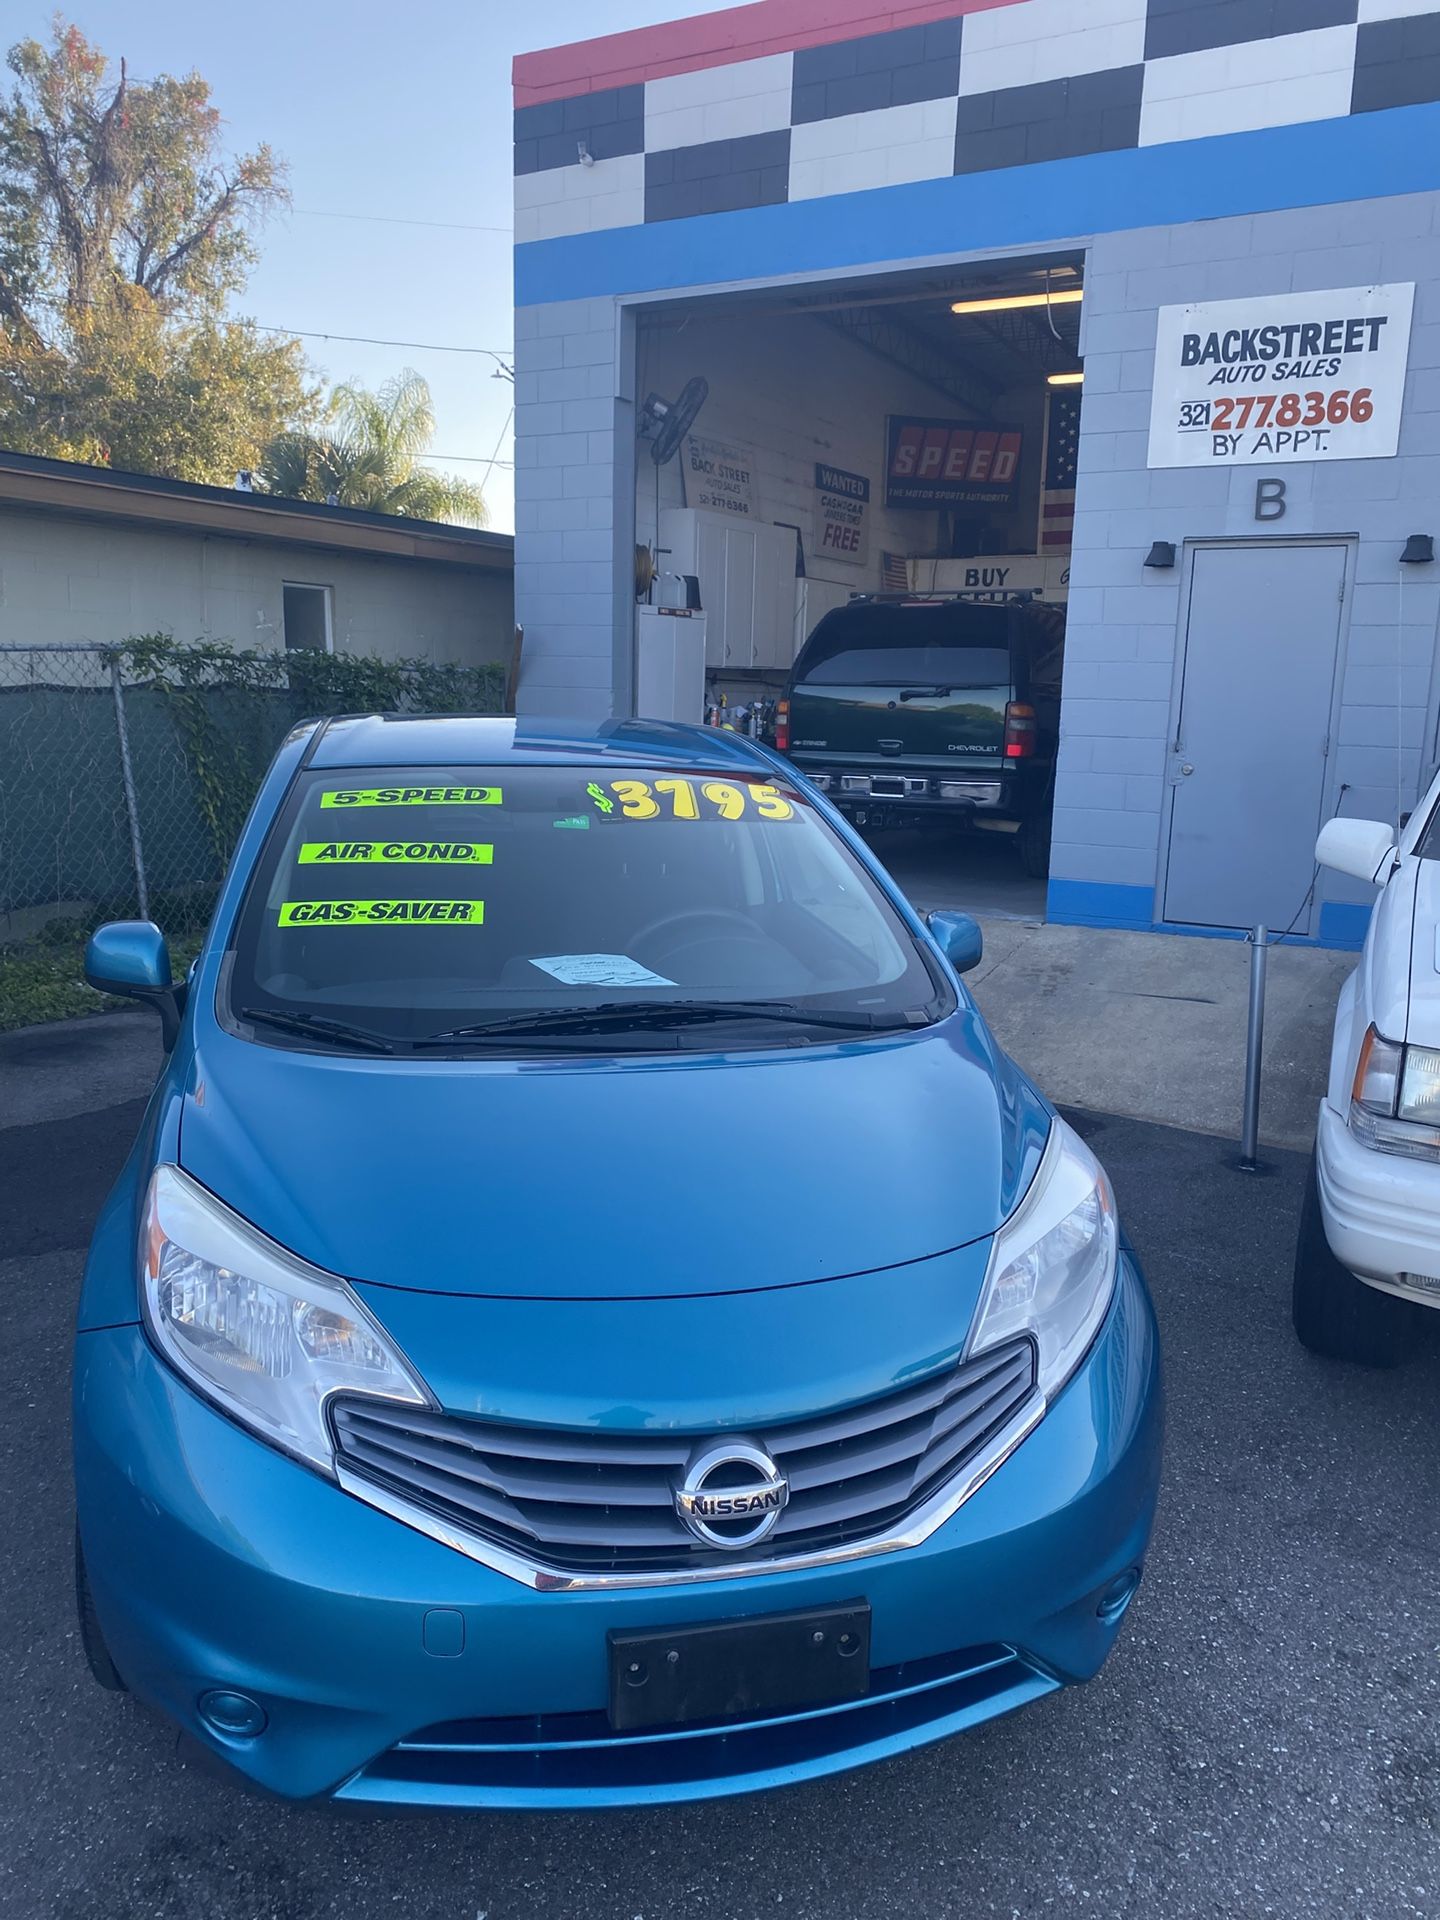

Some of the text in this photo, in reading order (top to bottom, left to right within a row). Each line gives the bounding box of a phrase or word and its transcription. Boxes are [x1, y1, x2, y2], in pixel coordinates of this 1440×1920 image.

[1181, 316, 1388, 367] BACKSTREET
[1207, 357, 1342, 386] AUTO SALES
[1178, 387, 1374, 431] 321 277.8366
[1212, 429, 1331, 456] BY APPT.
[691, 457, 751, 484] BACK STREET
[895, 445, 1016, 480] SPEED
[705, 478, 742, 494] AUTO SALES
[821, 469, 865, 496] WANTED
[888, 487, 1011, 503] THE MOTOR SPORTS AUTHORITY
[821, 495, 842, 510] CASH
[847, 503, 864, 517] CAR
[1254, 478, 1287, 521] B
[822, 523, 861, 552] FREE
[965, 568, 1010, 587] BUY
[947, 744, 998, 752] CHEVROLET
[332, 787, 490, 806] 5-SPEED
[314, 843, 481, 861] AIR COND.
[288, 901, 476, 923] GAS-SAVER
[691, 1491, 779, 1515] NISSAN
